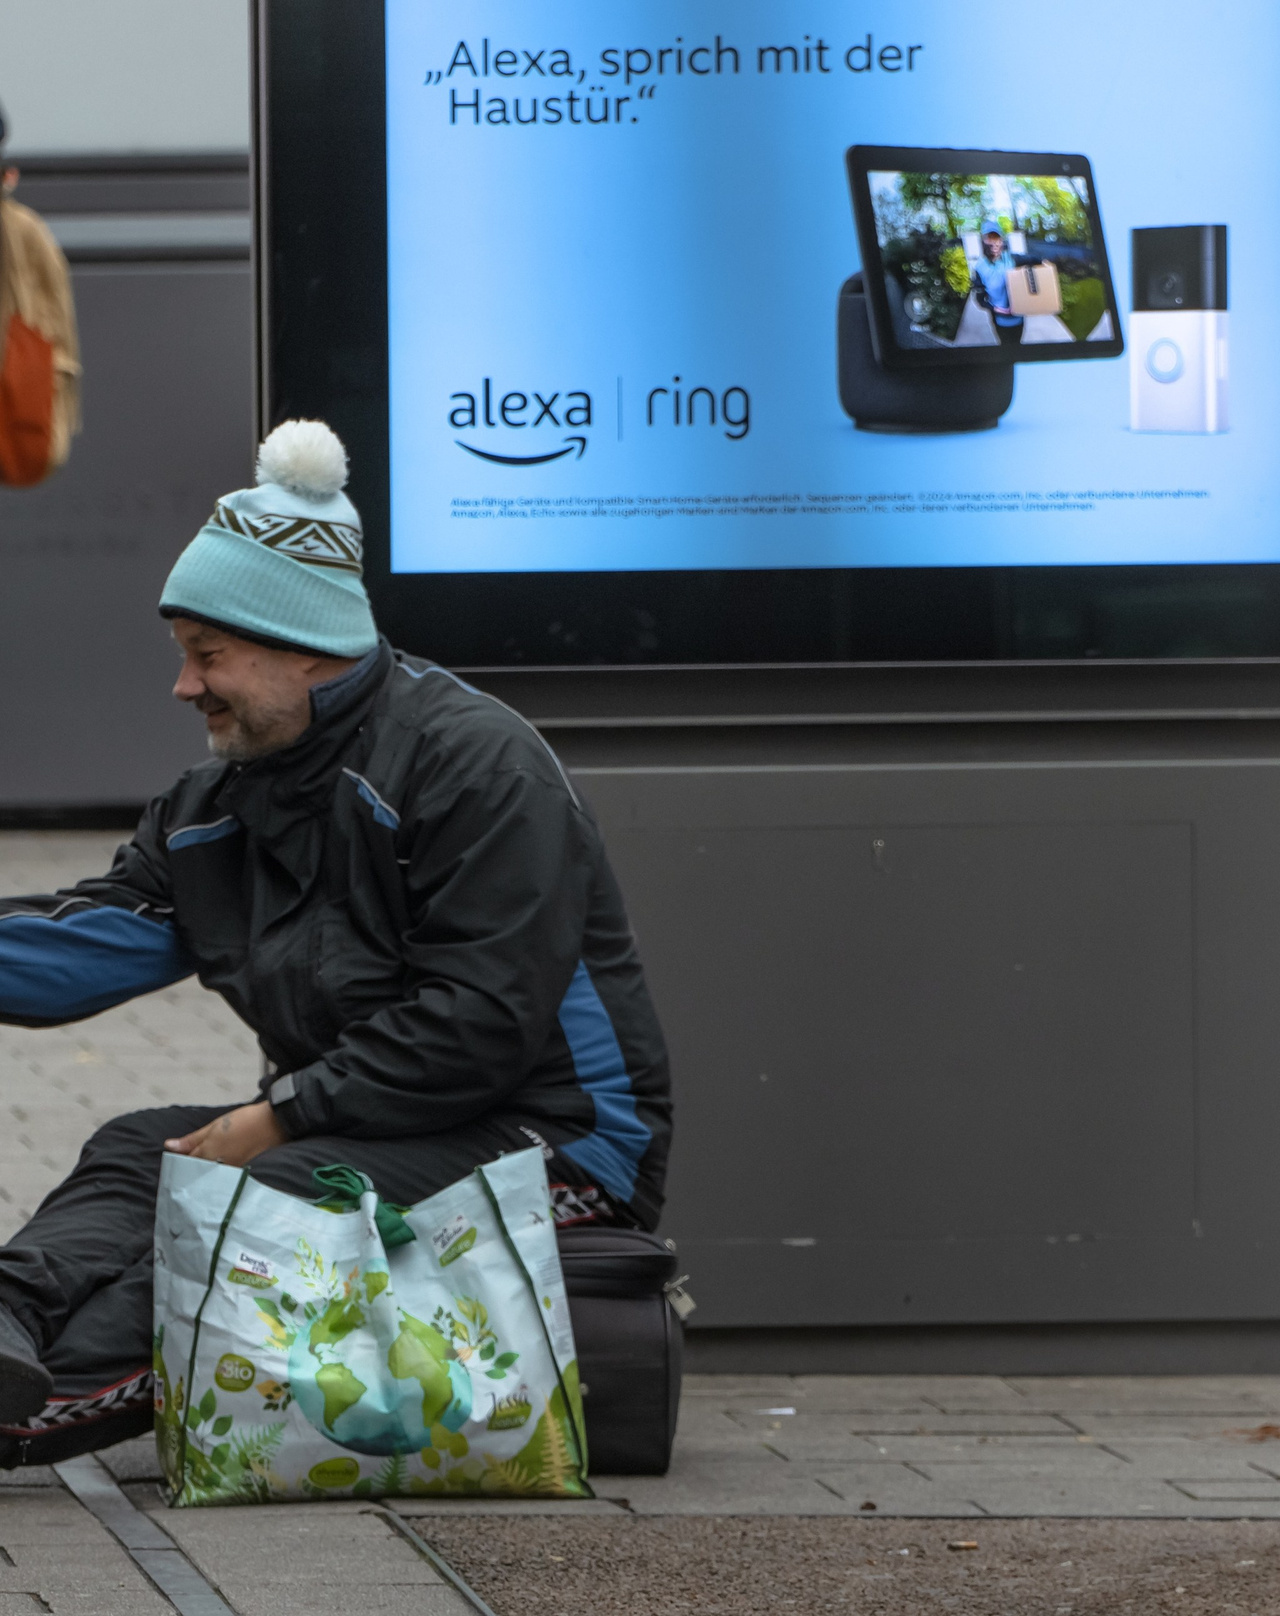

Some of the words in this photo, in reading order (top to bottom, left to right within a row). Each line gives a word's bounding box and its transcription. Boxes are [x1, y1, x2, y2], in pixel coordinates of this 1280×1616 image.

[423, 37, 587, 85] „Alexa,
[599, 35, 740, 85] sprich
[756, 34, 832, 74] mit
[844, 33, 923, 73] der
[448, 84, 657, 125] Haustür.“
[448, 377, 593, 428] alexa
[645, 374, 751, 441] ring
[222, 1359, 253, 1381] Bio
